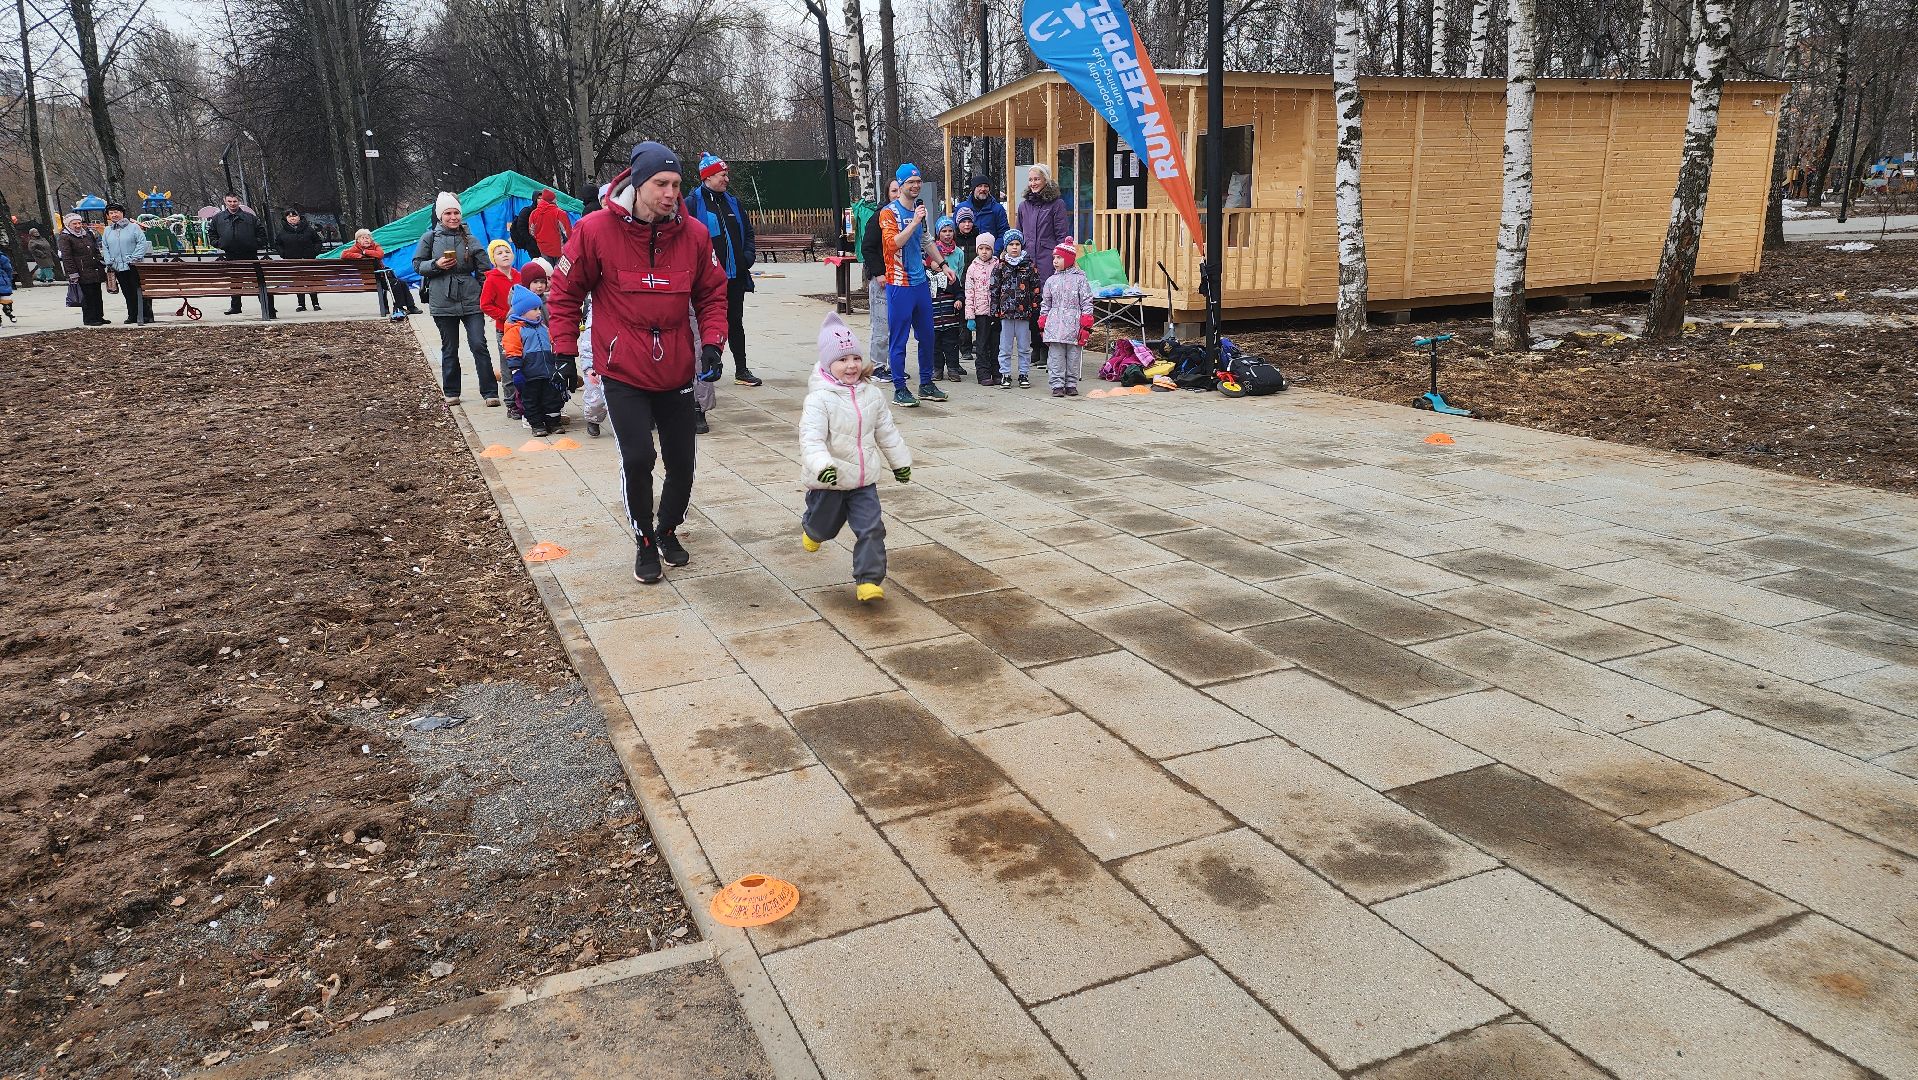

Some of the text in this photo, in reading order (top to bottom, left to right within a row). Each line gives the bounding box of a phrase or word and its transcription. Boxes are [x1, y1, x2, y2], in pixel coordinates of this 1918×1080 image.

[1087, 62, 1119, 124] Dolgoprudny
[1092, 48, 1124, 106] running club
[1137, 111, 1180, 179] RUN
